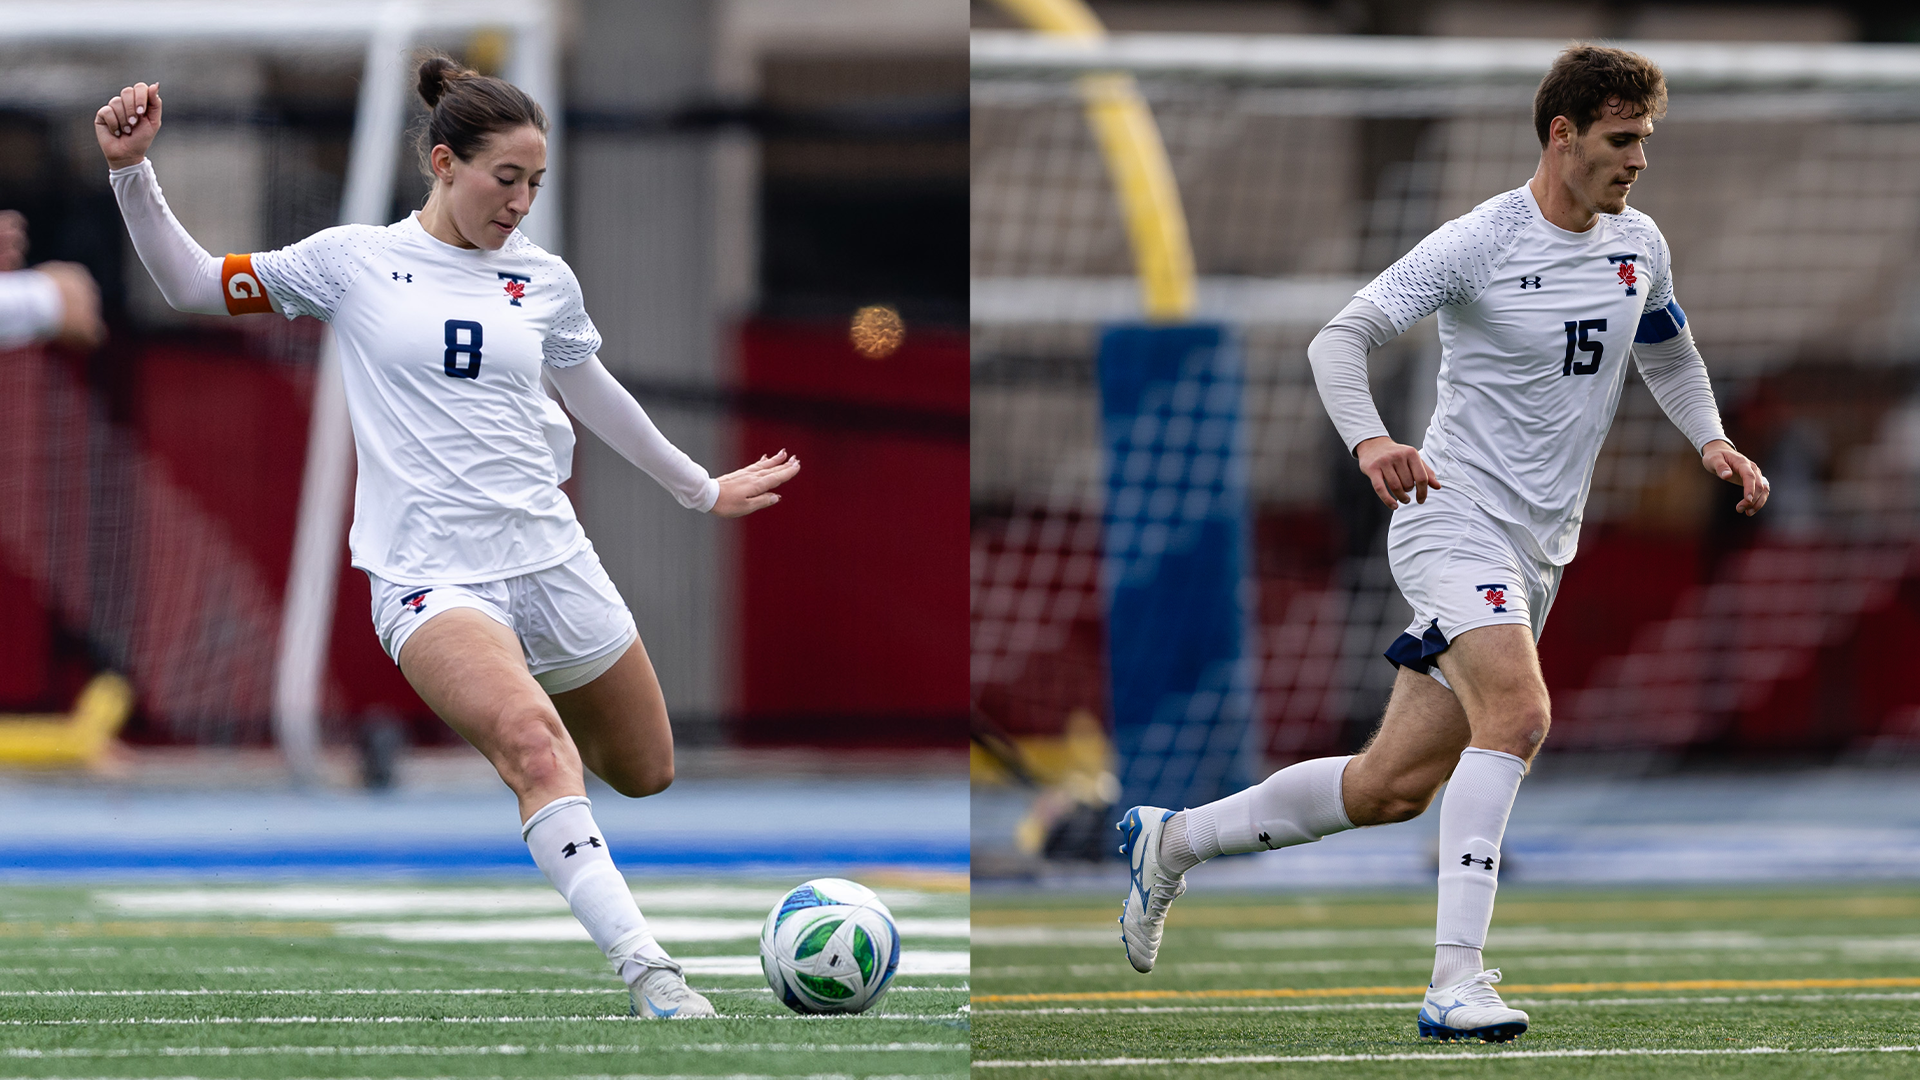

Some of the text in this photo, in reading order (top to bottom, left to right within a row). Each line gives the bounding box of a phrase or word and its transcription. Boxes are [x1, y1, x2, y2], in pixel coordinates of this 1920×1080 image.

[228, 272, 262, 299] G
[444, 319, 484, 380] 8
[1563, 318, 1608, 377] 15
